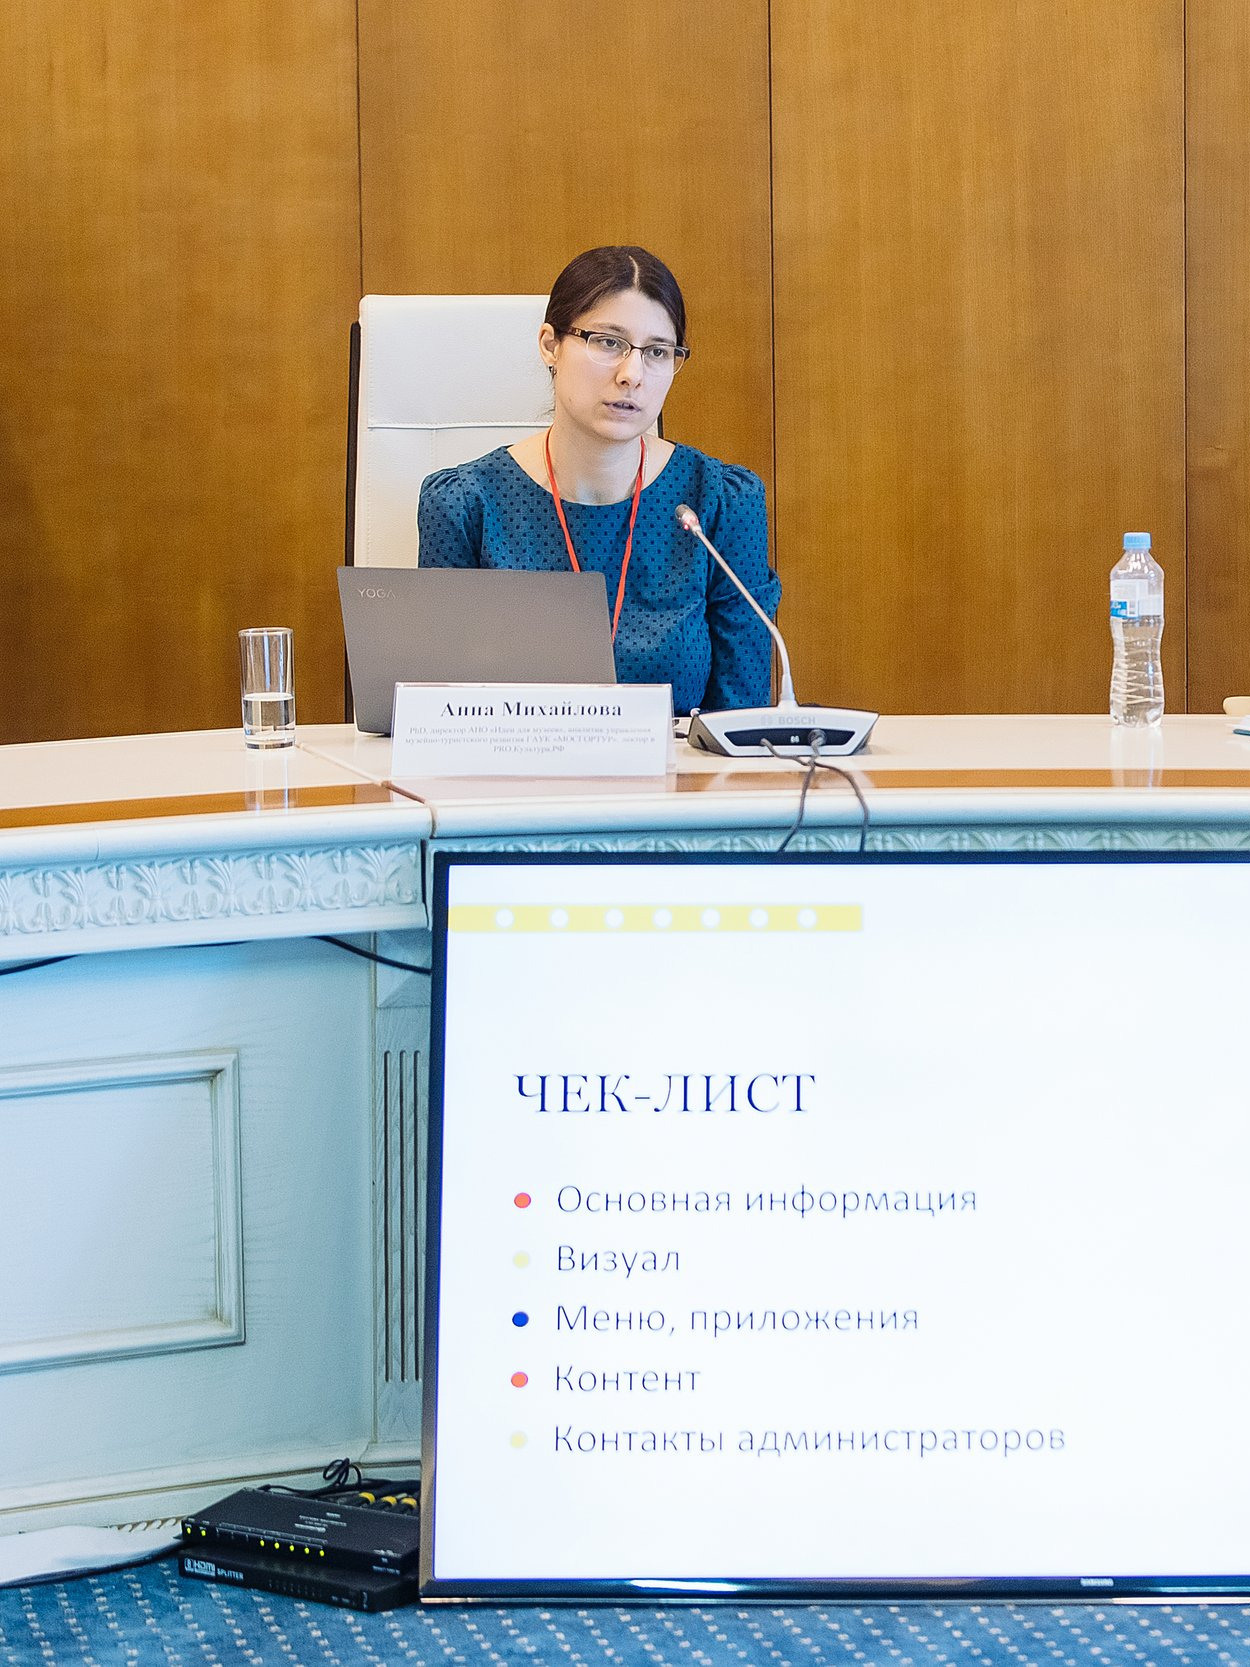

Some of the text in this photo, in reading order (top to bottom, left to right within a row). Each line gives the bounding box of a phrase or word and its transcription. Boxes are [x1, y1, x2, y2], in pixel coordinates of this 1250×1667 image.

[357, 588, 397, 599] YOGA
[440, 700, 622, 717] Анна Михайлова
[778, 715, 816, 725] BOSCH
[513, 1073, 817, 1113] ЧЕК-ЛИСТ
[557, 1184, 977, 1218] Основная информация
[557, 1246, 680, 1278] Визуал
[556, 1305, 918, 1338] Меню, приложения
[556, 1366, 701, 1392] Контент
[554, 1425, 1066, 1459] Контакты администраторов
